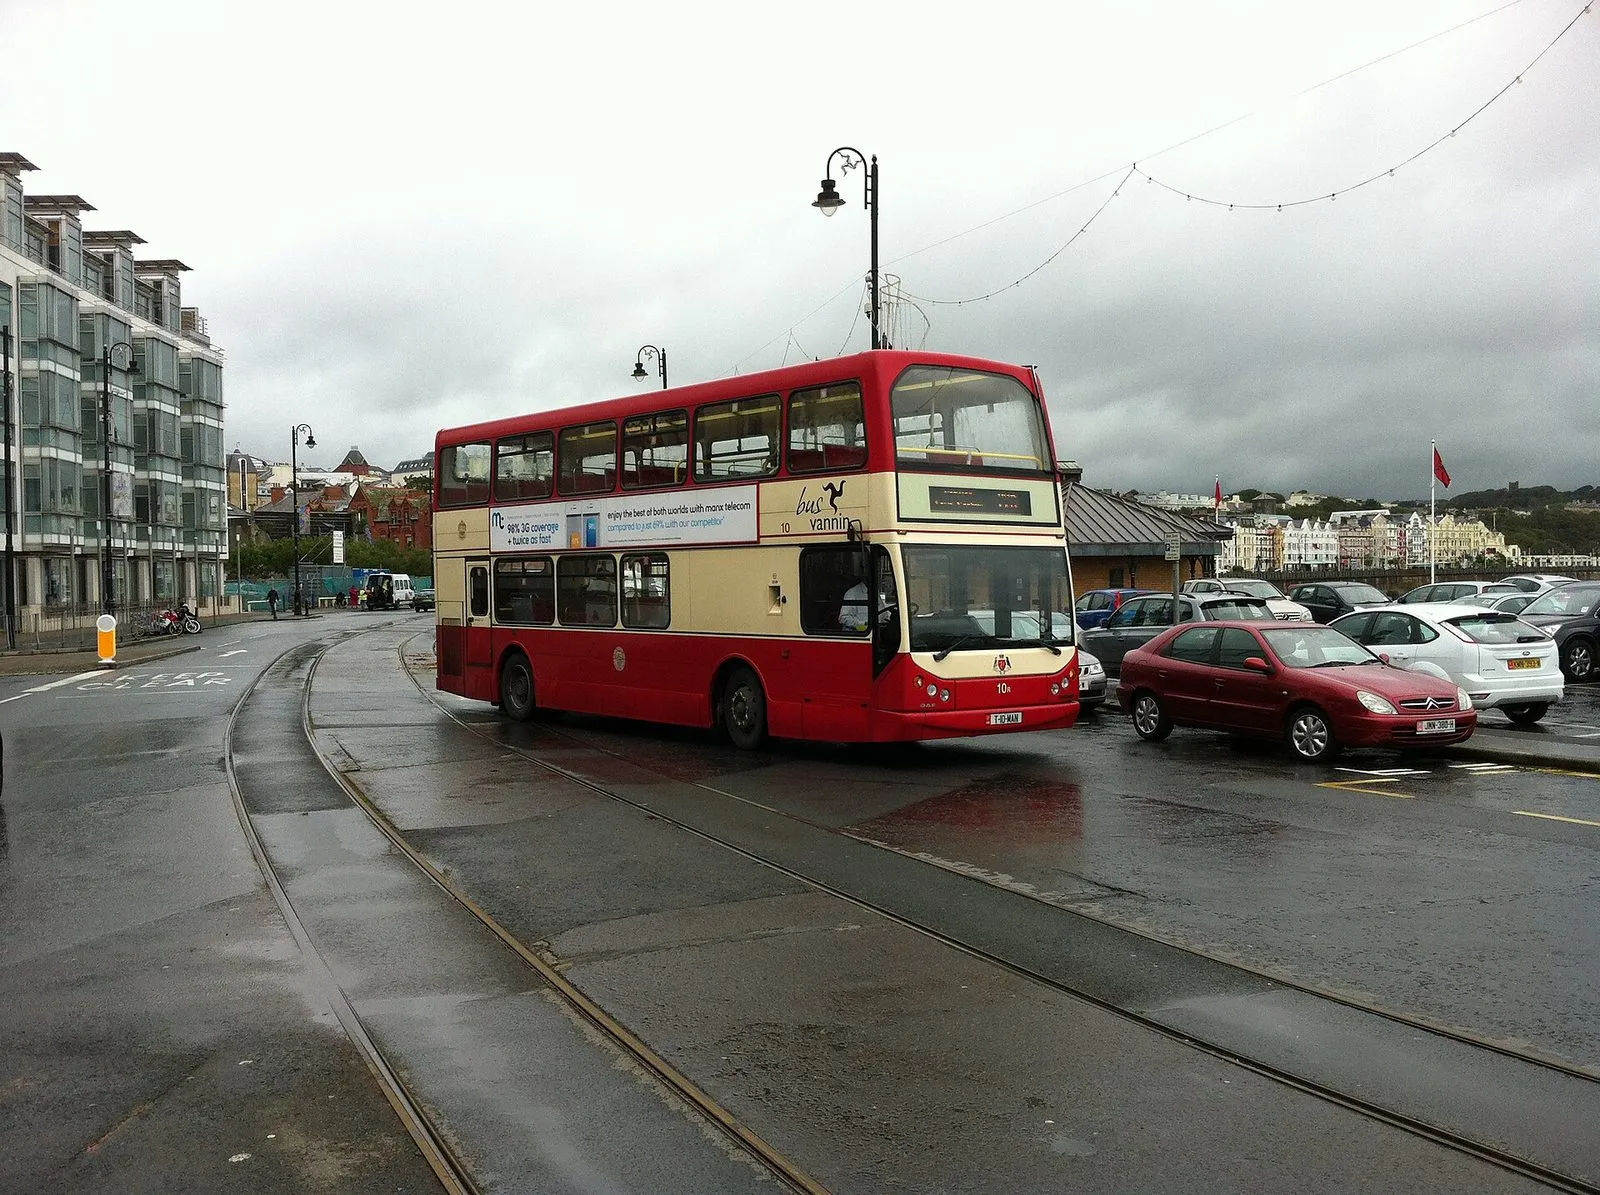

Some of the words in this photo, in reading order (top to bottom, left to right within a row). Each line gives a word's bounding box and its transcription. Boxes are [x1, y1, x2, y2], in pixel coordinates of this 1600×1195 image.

[796, 486, 824, 515] bus
[607, 510, 622, 521] enjoy
[623, 509, 633, 518] the
[633, 508, 646, 517] best
[646, 507, 653, 517] of
[653, 506, 667, 516] both
[667, 504, 689, 515] worlds
[690, 503, 704, 513] with
[705, 503, 724, 512] manx
[724, 501, 751, 511] telecom
[521, 522, 530, 533] 3G
[530, 521, 559, 534] coverage
[607, 521, 635, 533] compared
[635, 522, 641, 531] to
[640, 521, 652, 532] just
[664, 518, 679, 529] with
[678, 519, 690, 528] our
[780, 522, 791, 534] 10
[809, 512, 850, 531] vannin
[512, 534, 530, 545] twice
[530, 537, 538, 545] as
[539, 533, 551, 544] fast
[112, 671, 225, 684] KEEP
[76, 678, 232, 691] CLEAR
